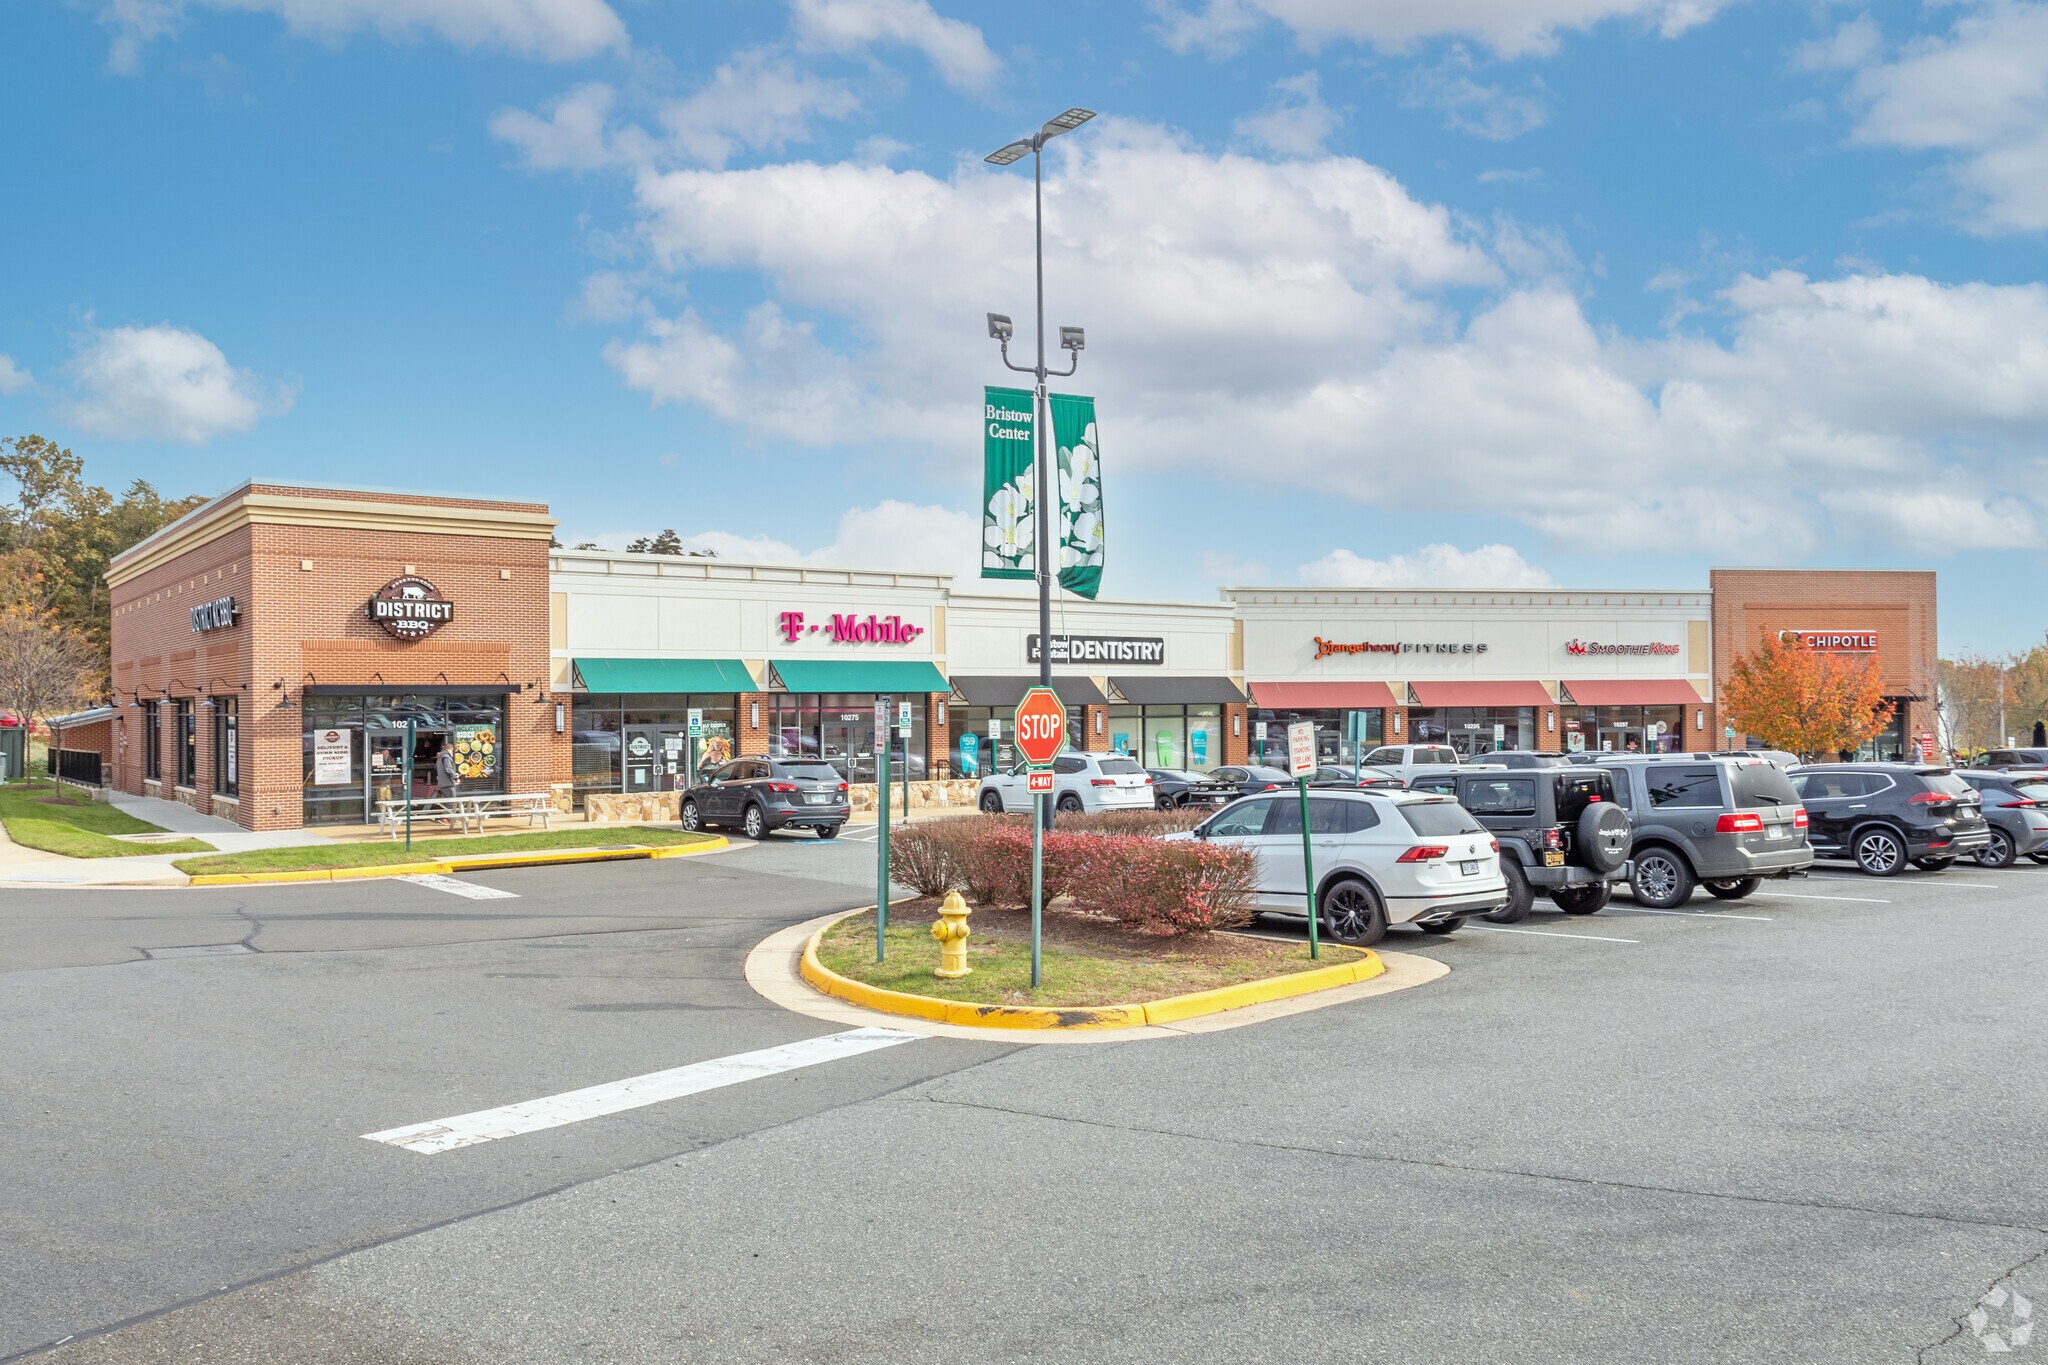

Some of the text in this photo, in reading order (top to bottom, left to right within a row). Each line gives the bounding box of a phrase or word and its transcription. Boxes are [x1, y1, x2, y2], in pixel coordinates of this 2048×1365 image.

[985, 404, 1033, 423] Bristow
[989, 423, 1031, 441] Center
[376, 602, 452, 619] DISTRICT
[396, 620, 429, 630] BBQ
[1807, 635, 1877, 647] CHIPOTLE
[1070, 640, 1163, 661] DENTISTRY
[1403, 643, 1489, 654] FITNESS
[392, 720, 417, 729] 1021
[1021, 713, 1060, 740] STOP
[962, 736, 976, 746] $59
[1292, 734, 1310, 744] PARKING
[1031, 776, 1052, 788] 4-WAY
